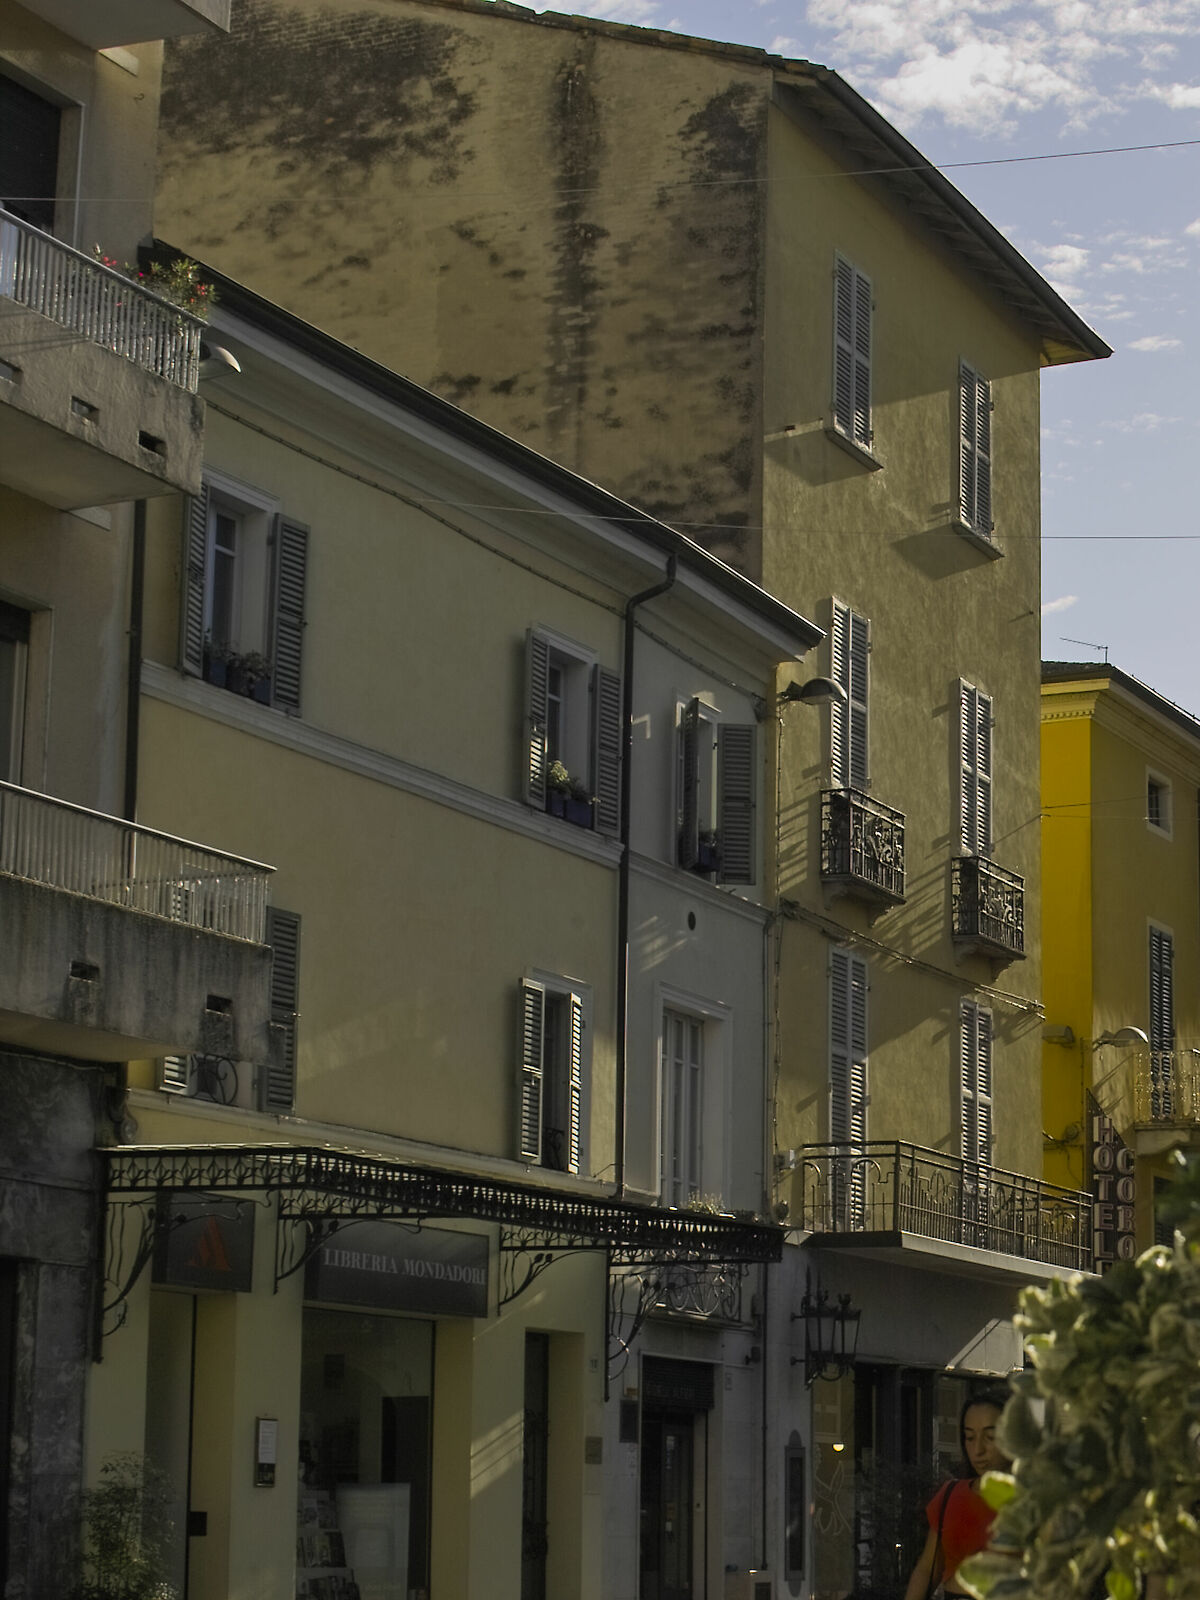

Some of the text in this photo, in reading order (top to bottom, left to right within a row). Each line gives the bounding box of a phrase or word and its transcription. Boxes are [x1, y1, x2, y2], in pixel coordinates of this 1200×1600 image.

[1092, 1115, 1115, 1259] HOTEL
[323, 1247, 486, 1286] LIBRERIA MONDADORI
